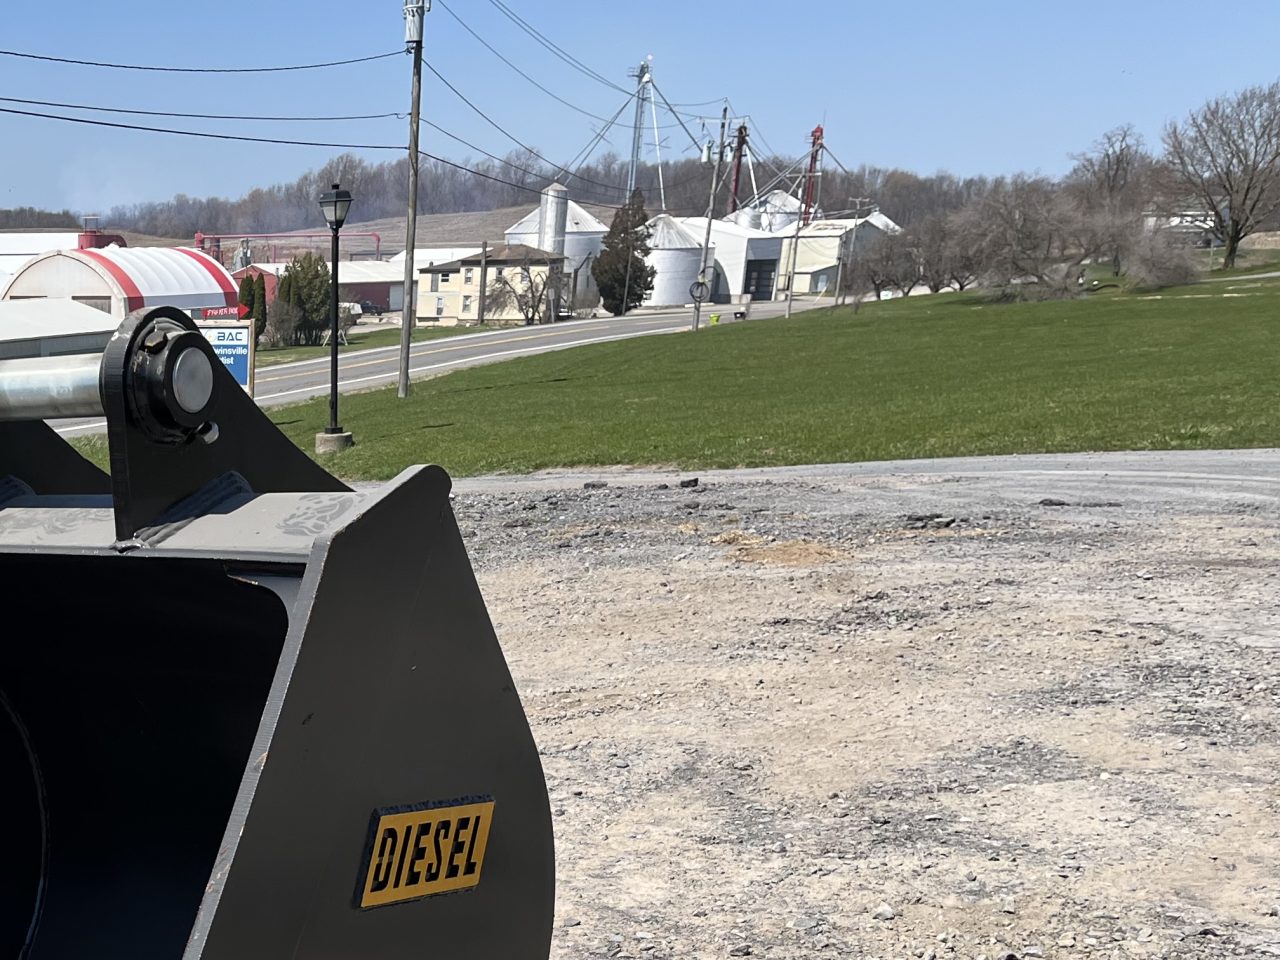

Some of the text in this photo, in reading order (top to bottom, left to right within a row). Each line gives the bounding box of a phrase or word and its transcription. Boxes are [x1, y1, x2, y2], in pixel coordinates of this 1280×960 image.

[217, 331, 243, 342] BAC
[213, 346, 248, 355] winsville
[370, 815, 481, 893] DIESEL
